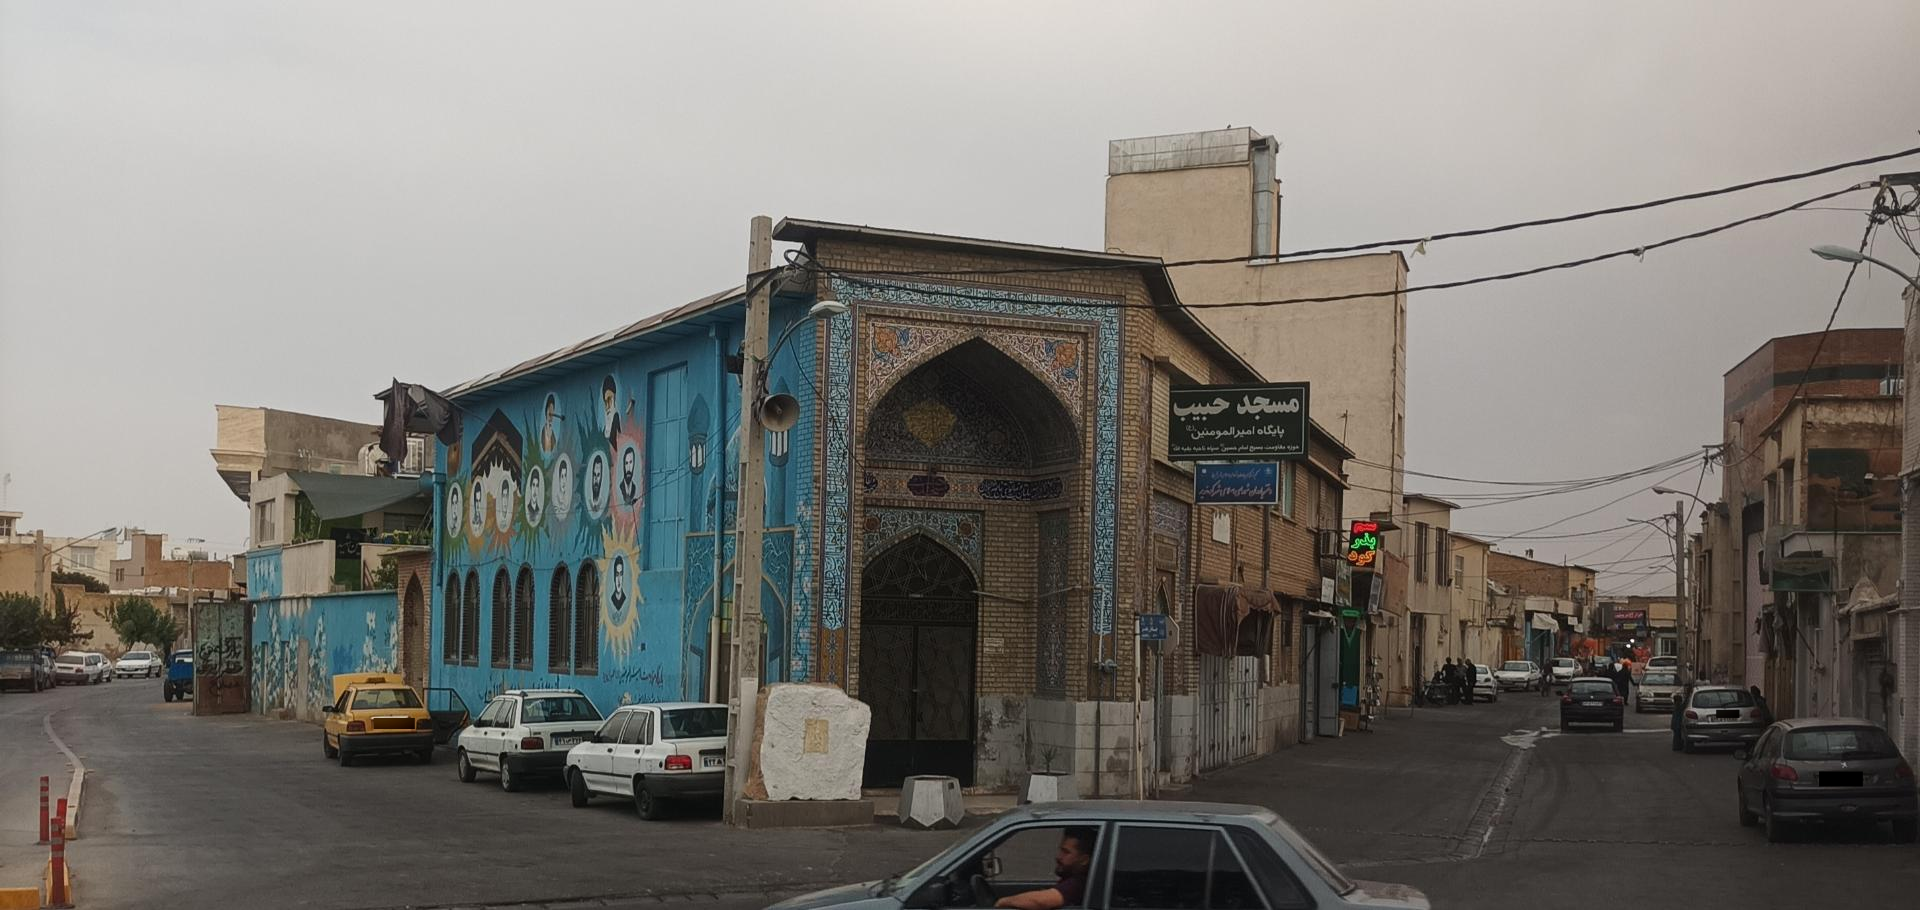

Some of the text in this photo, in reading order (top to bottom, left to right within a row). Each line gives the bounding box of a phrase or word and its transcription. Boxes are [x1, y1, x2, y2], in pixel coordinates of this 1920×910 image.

[1173, 394, 1300, 422] مسجد حبیب
[1257, 424, 1285, 439] پایگاه
[1238, 443, 1249, 452] امام
[1249, 443, 1264, 452] بسیج
[1265, 444, 1286, 452] مقاومت
[1354, 523, 1377, 534] سم
[1351, 532, 1376, 549] بذر
[1348, 550, 1376, 566] کود
